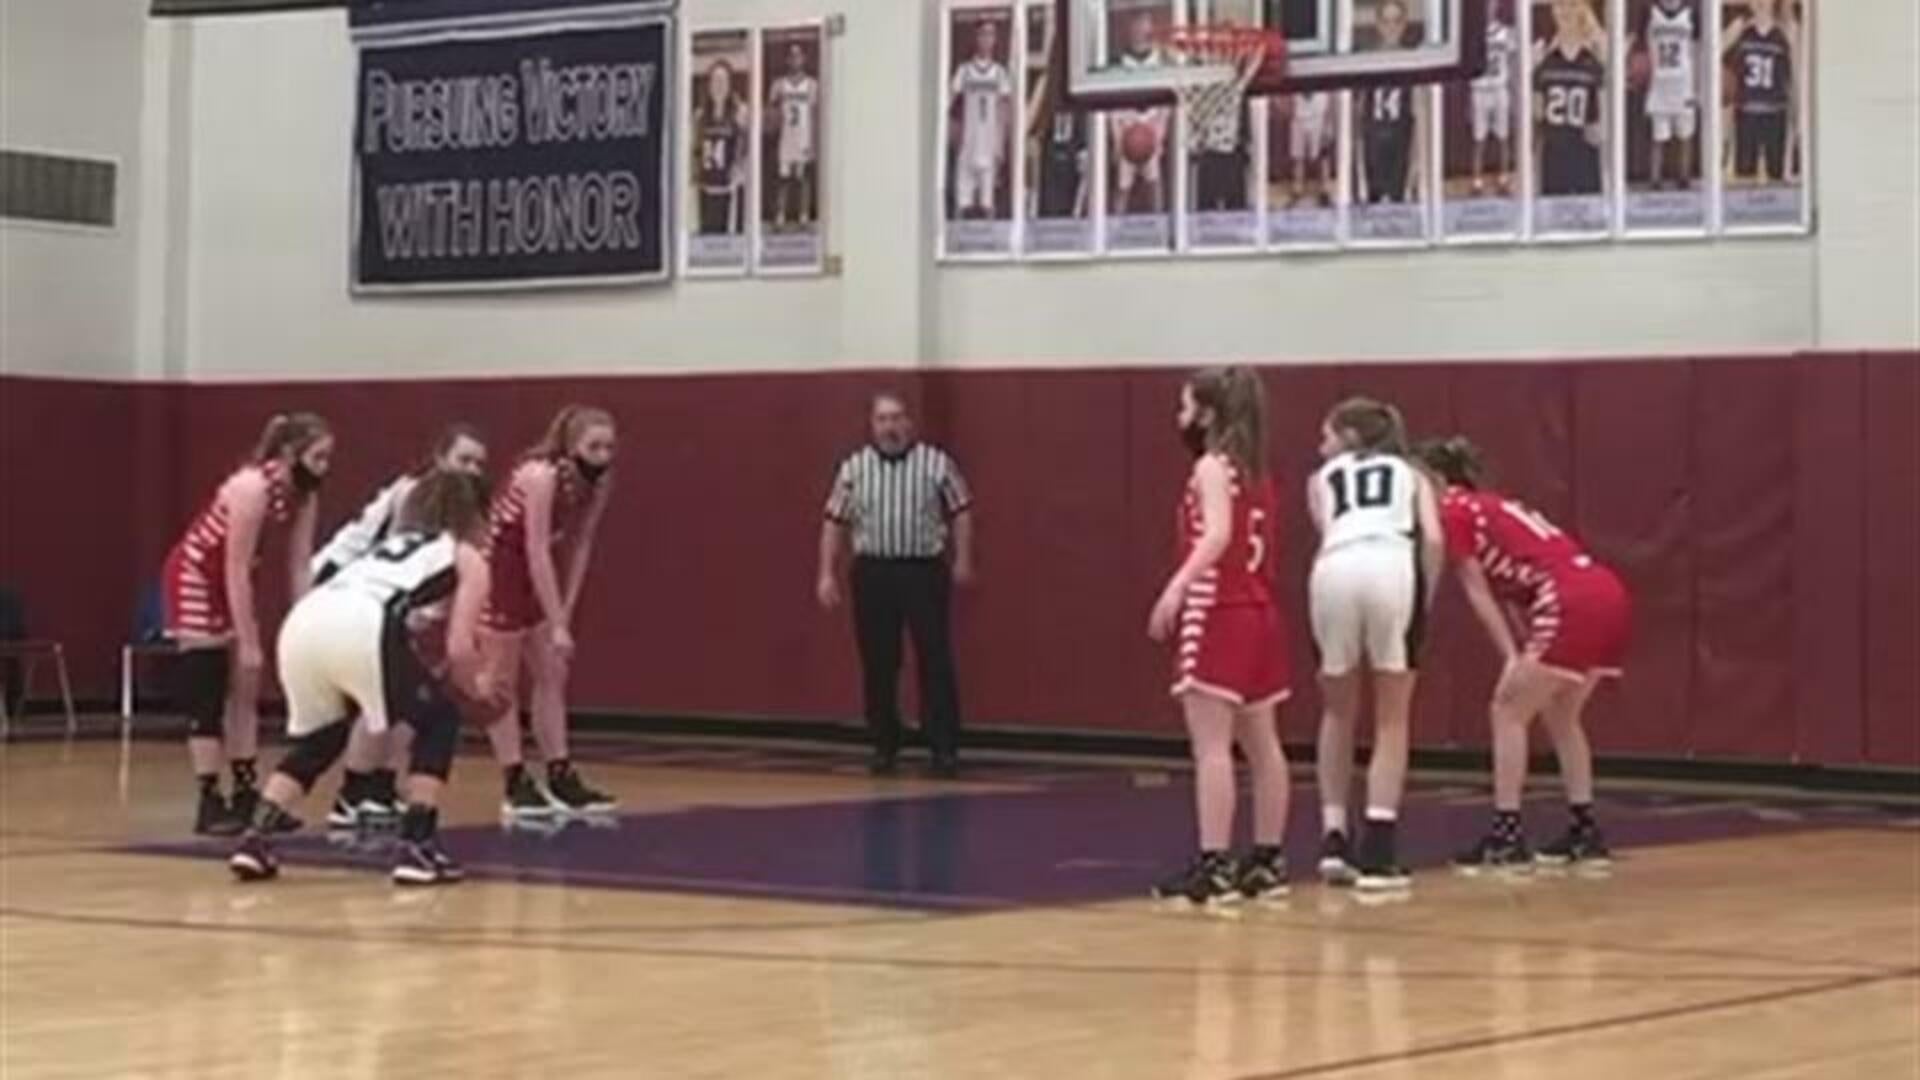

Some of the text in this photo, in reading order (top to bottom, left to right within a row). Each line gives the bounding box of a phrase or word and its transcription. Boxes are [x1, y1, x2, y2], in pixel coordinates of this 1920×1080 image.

[1659, 42, 1681, 68] 12
[1744, 54, 1774, 89] 31
[364, 58, 656, 153] PURSUING VICTORY
[1546, 85, 1588, 127] 20
[376, 171, 641, 260] WITH HONOR
[1326, 463, 1395, 520] 10
[1247, 507, 1266, 574] 5
